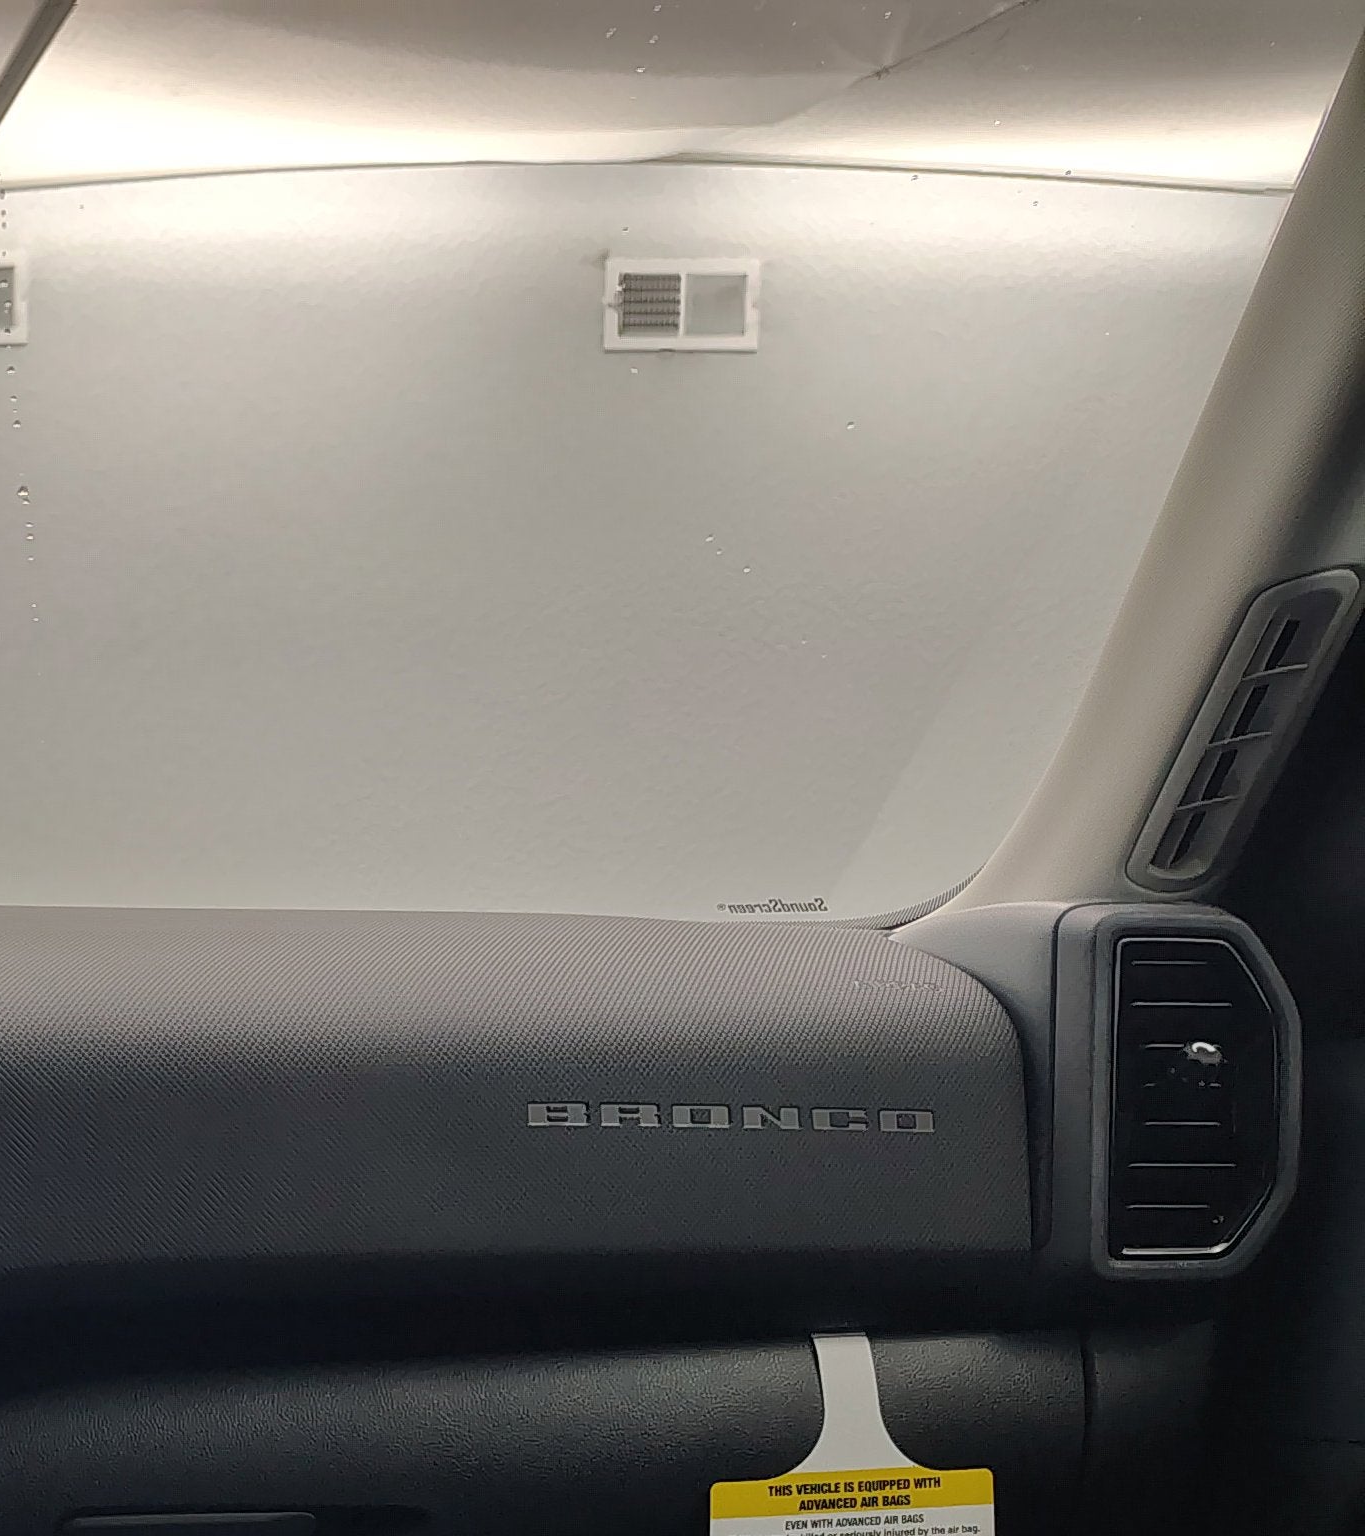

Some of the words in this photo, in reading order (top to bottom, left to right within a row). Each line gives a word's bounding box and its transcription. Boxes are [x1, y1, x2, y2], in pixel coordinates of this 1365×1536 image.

[526, 1101, 936, 1133] BRONCO
[768, 1485, 793, 1497] THIS
[796, 1482, 841, 1495] VEHICLE
[844, 1482, 854, 1493] IS
[858, 1478, 910, 1492] EQUIPPED
[914, 1477, 941, 1489] WITH
[799, 1498, 857, 1512] ADVANCED
[860, 1496, 879, 1508] AIR
[882, 1495, 911, 1506] BAGS
[785, 1520, 808, 1530] EVEN
[810, 1518, 833, 1529] WITH
[836, 1516, 881, 1527] ADVANCED
[884, 1515, 899, 1525] AIR
[901, 1514, 924, 1524] BAGS
[918, 1527, 929, 1536] by
[931, 1526, 945, 1535] the
[948, 1525, 959, 1534] air
[961, 1524, 981, 1534] bag.
